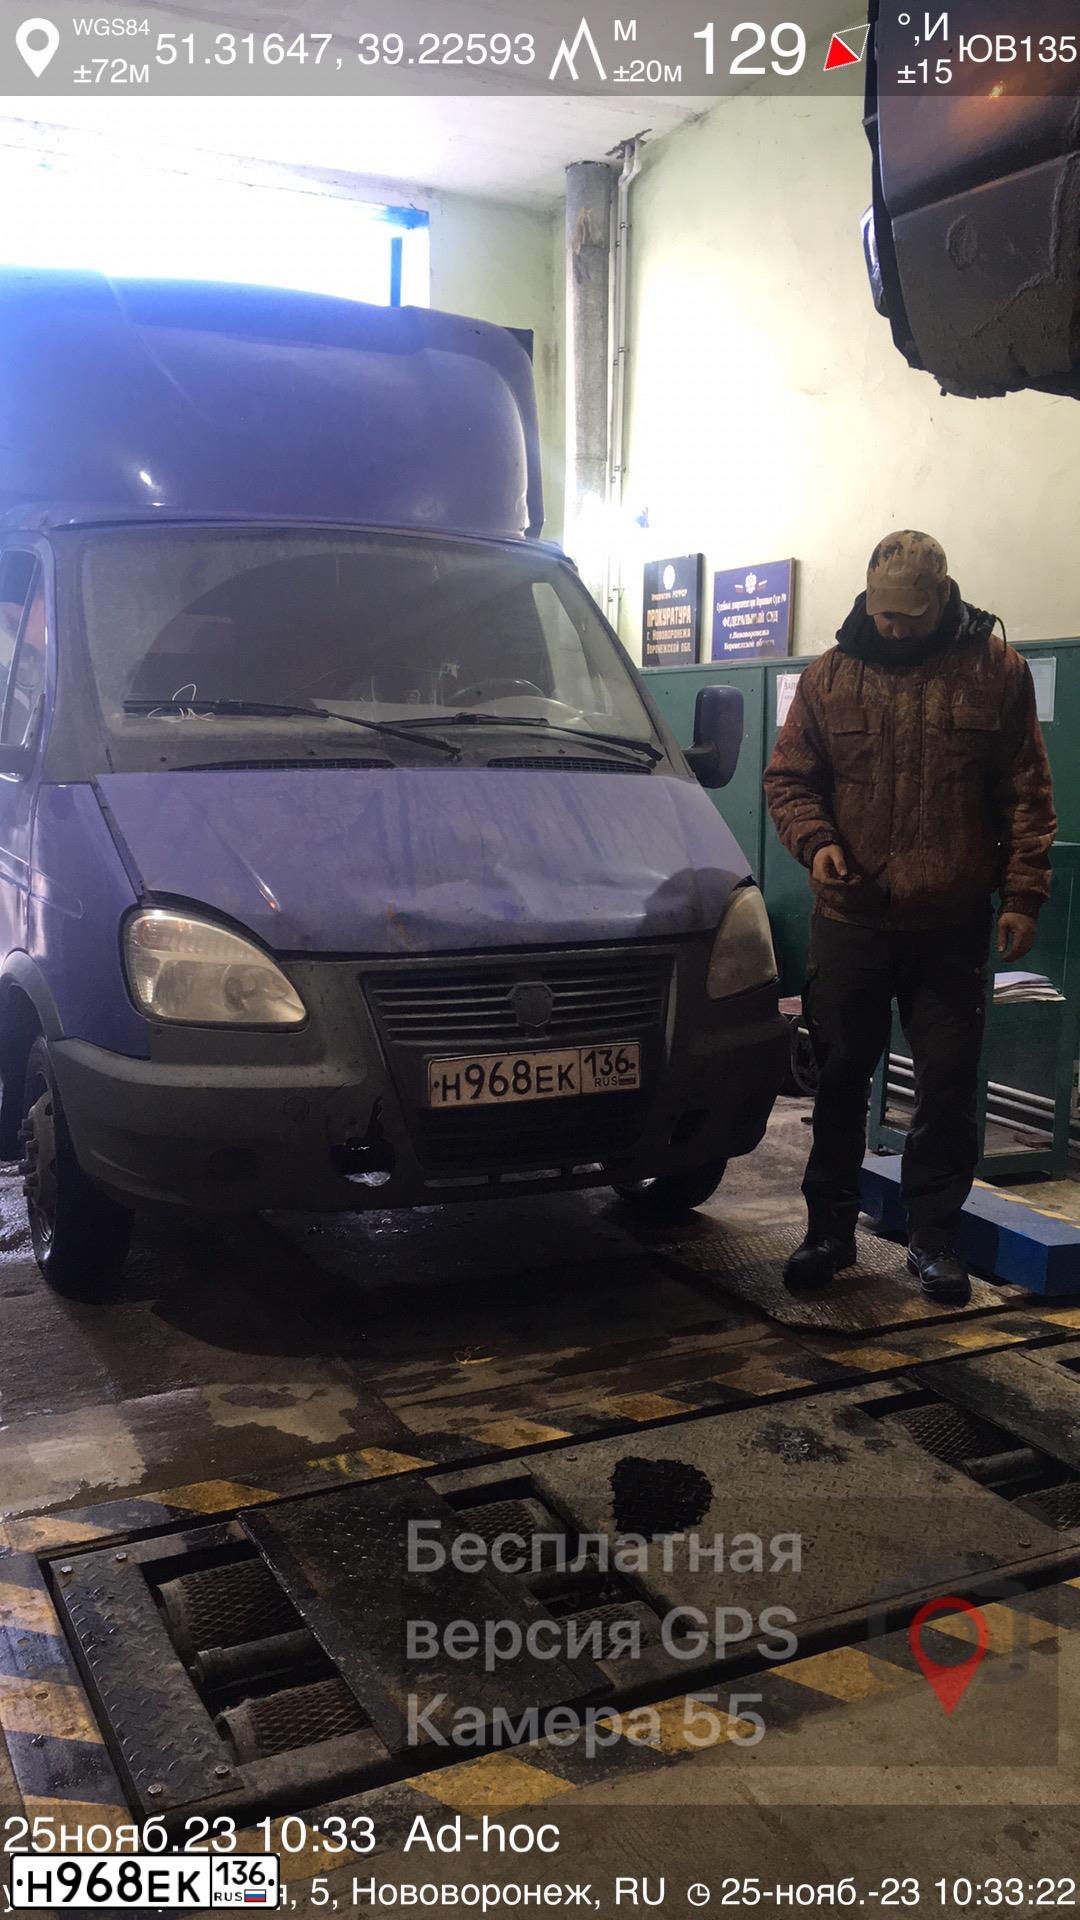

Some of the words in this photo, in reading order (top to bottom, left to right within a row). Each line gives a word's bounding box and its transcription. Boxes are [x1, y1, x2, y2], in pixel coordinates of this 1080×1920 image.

[646, 605, 692, 628] ПРОКУРАТУРА
[441, 1060, 576, 1102] Н968ЕК
[583, 1046, 630, 1077] 136
[594, 1076, 618, 1088] RUS
